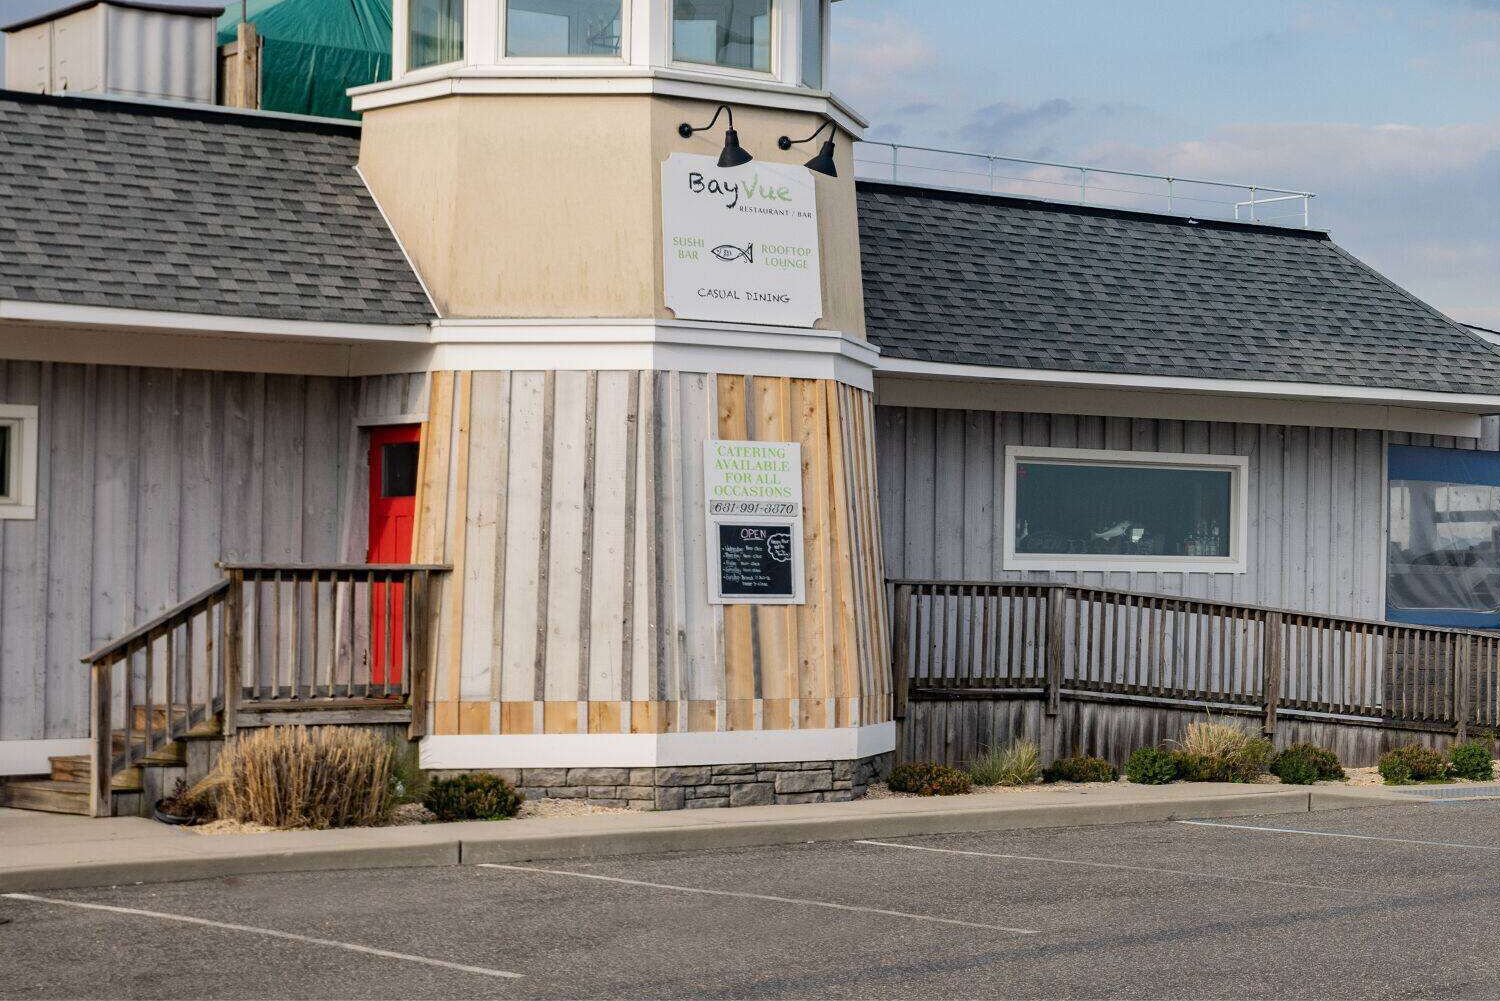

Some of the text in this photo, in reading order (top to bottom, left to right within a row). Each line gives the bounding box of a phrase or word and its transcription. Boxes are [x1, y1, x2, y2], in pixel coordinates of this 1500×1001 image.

[739, 206, 789, 217] RESTAURANT
[797, 211, 812, 219] BAR
[672, 236, 704, 248] SUSHI
[678, 249, 699, 260] BAR
[761, 244, 812, 257] ROOFTOP
[765, 257, 808, 269] LOUNGE
[697, 287, 740, 301] CASUAL
[746, 291, 790, 304] DINING
[716, 445, 786, 459] CATERING
[714, 459, 790, 472] AVAILABLE
[724, 472, 781, 485] FOR ALL
[713, 485, 792, 498] OCCASIONS
[740, 528, 767, 539] OPEN
